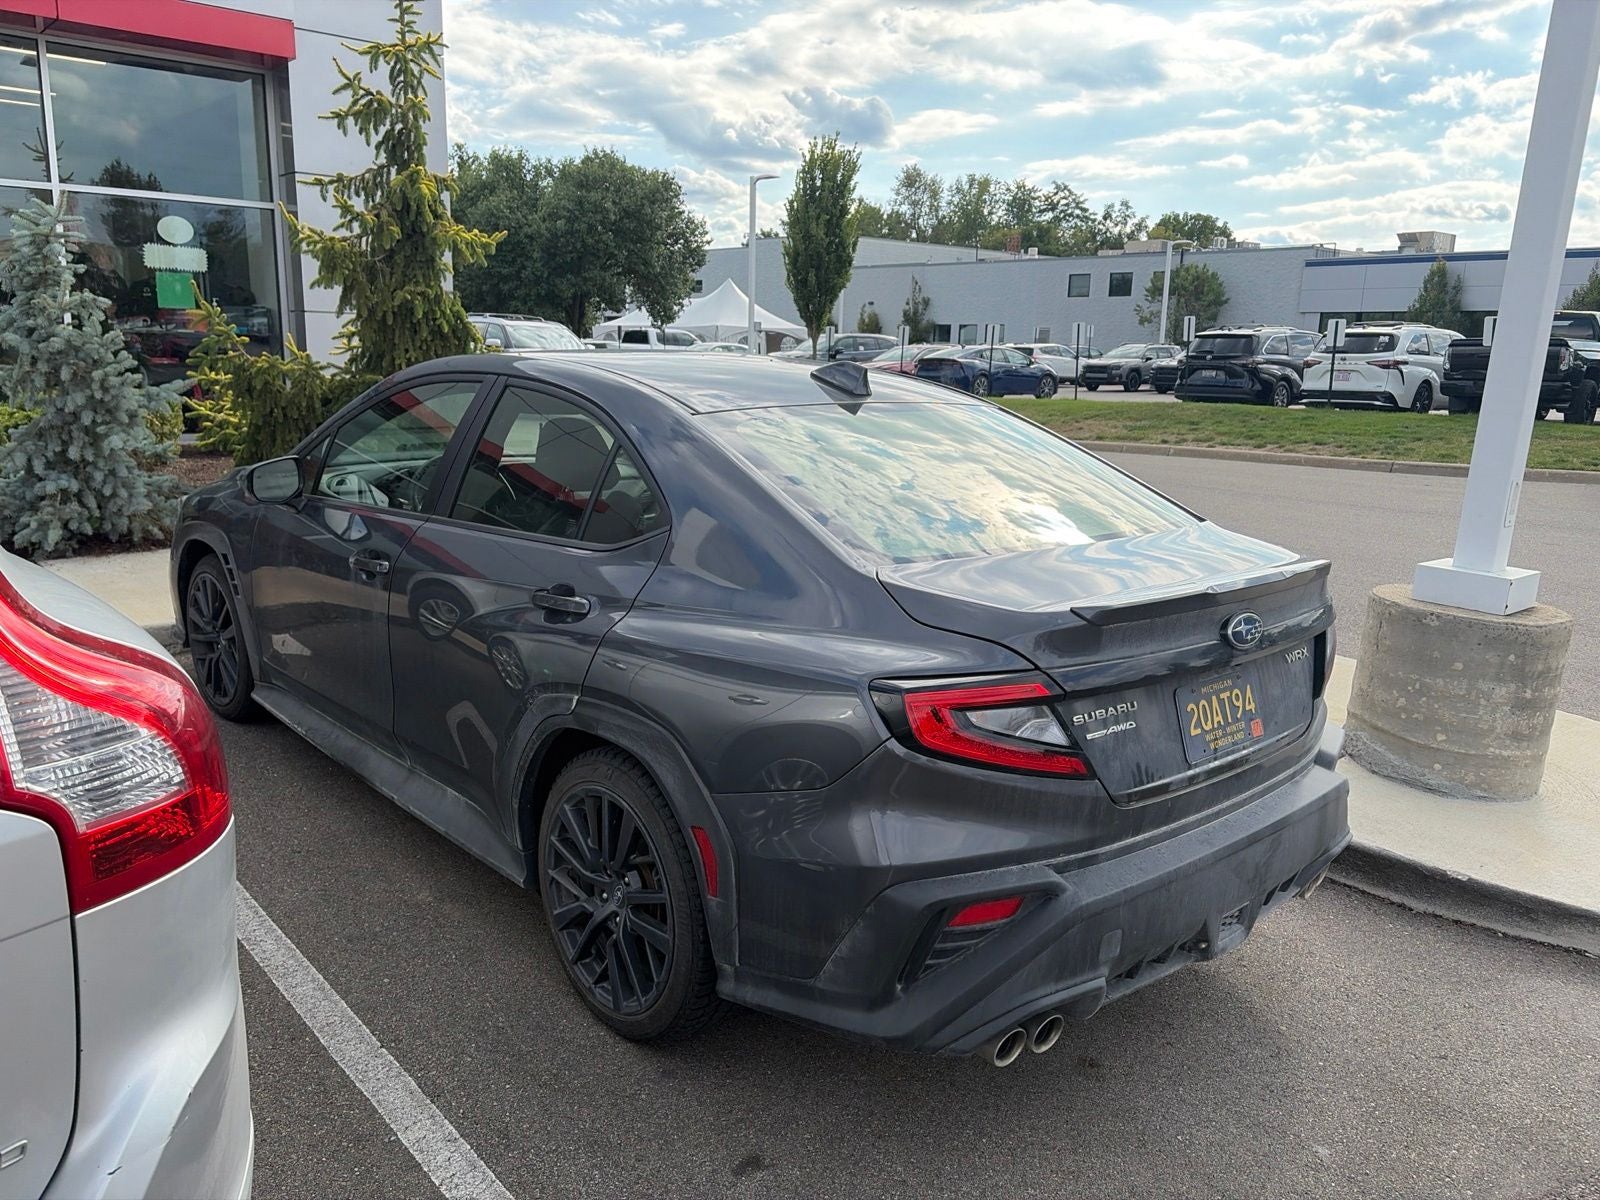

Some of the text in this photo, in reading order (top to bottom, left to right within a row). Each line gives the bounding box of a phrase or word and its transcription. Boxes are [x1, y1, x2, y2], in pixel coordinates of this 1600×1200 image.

[1285, 646, 1309, 663] WRX
[1201, 679, 1233, 694] MICHIGAN
[1072, 701, 1138, 726] SUBARU
[1106, 721, 1137, 735] AWD
[1209, 731, 1245, 750] WONDERLAND
